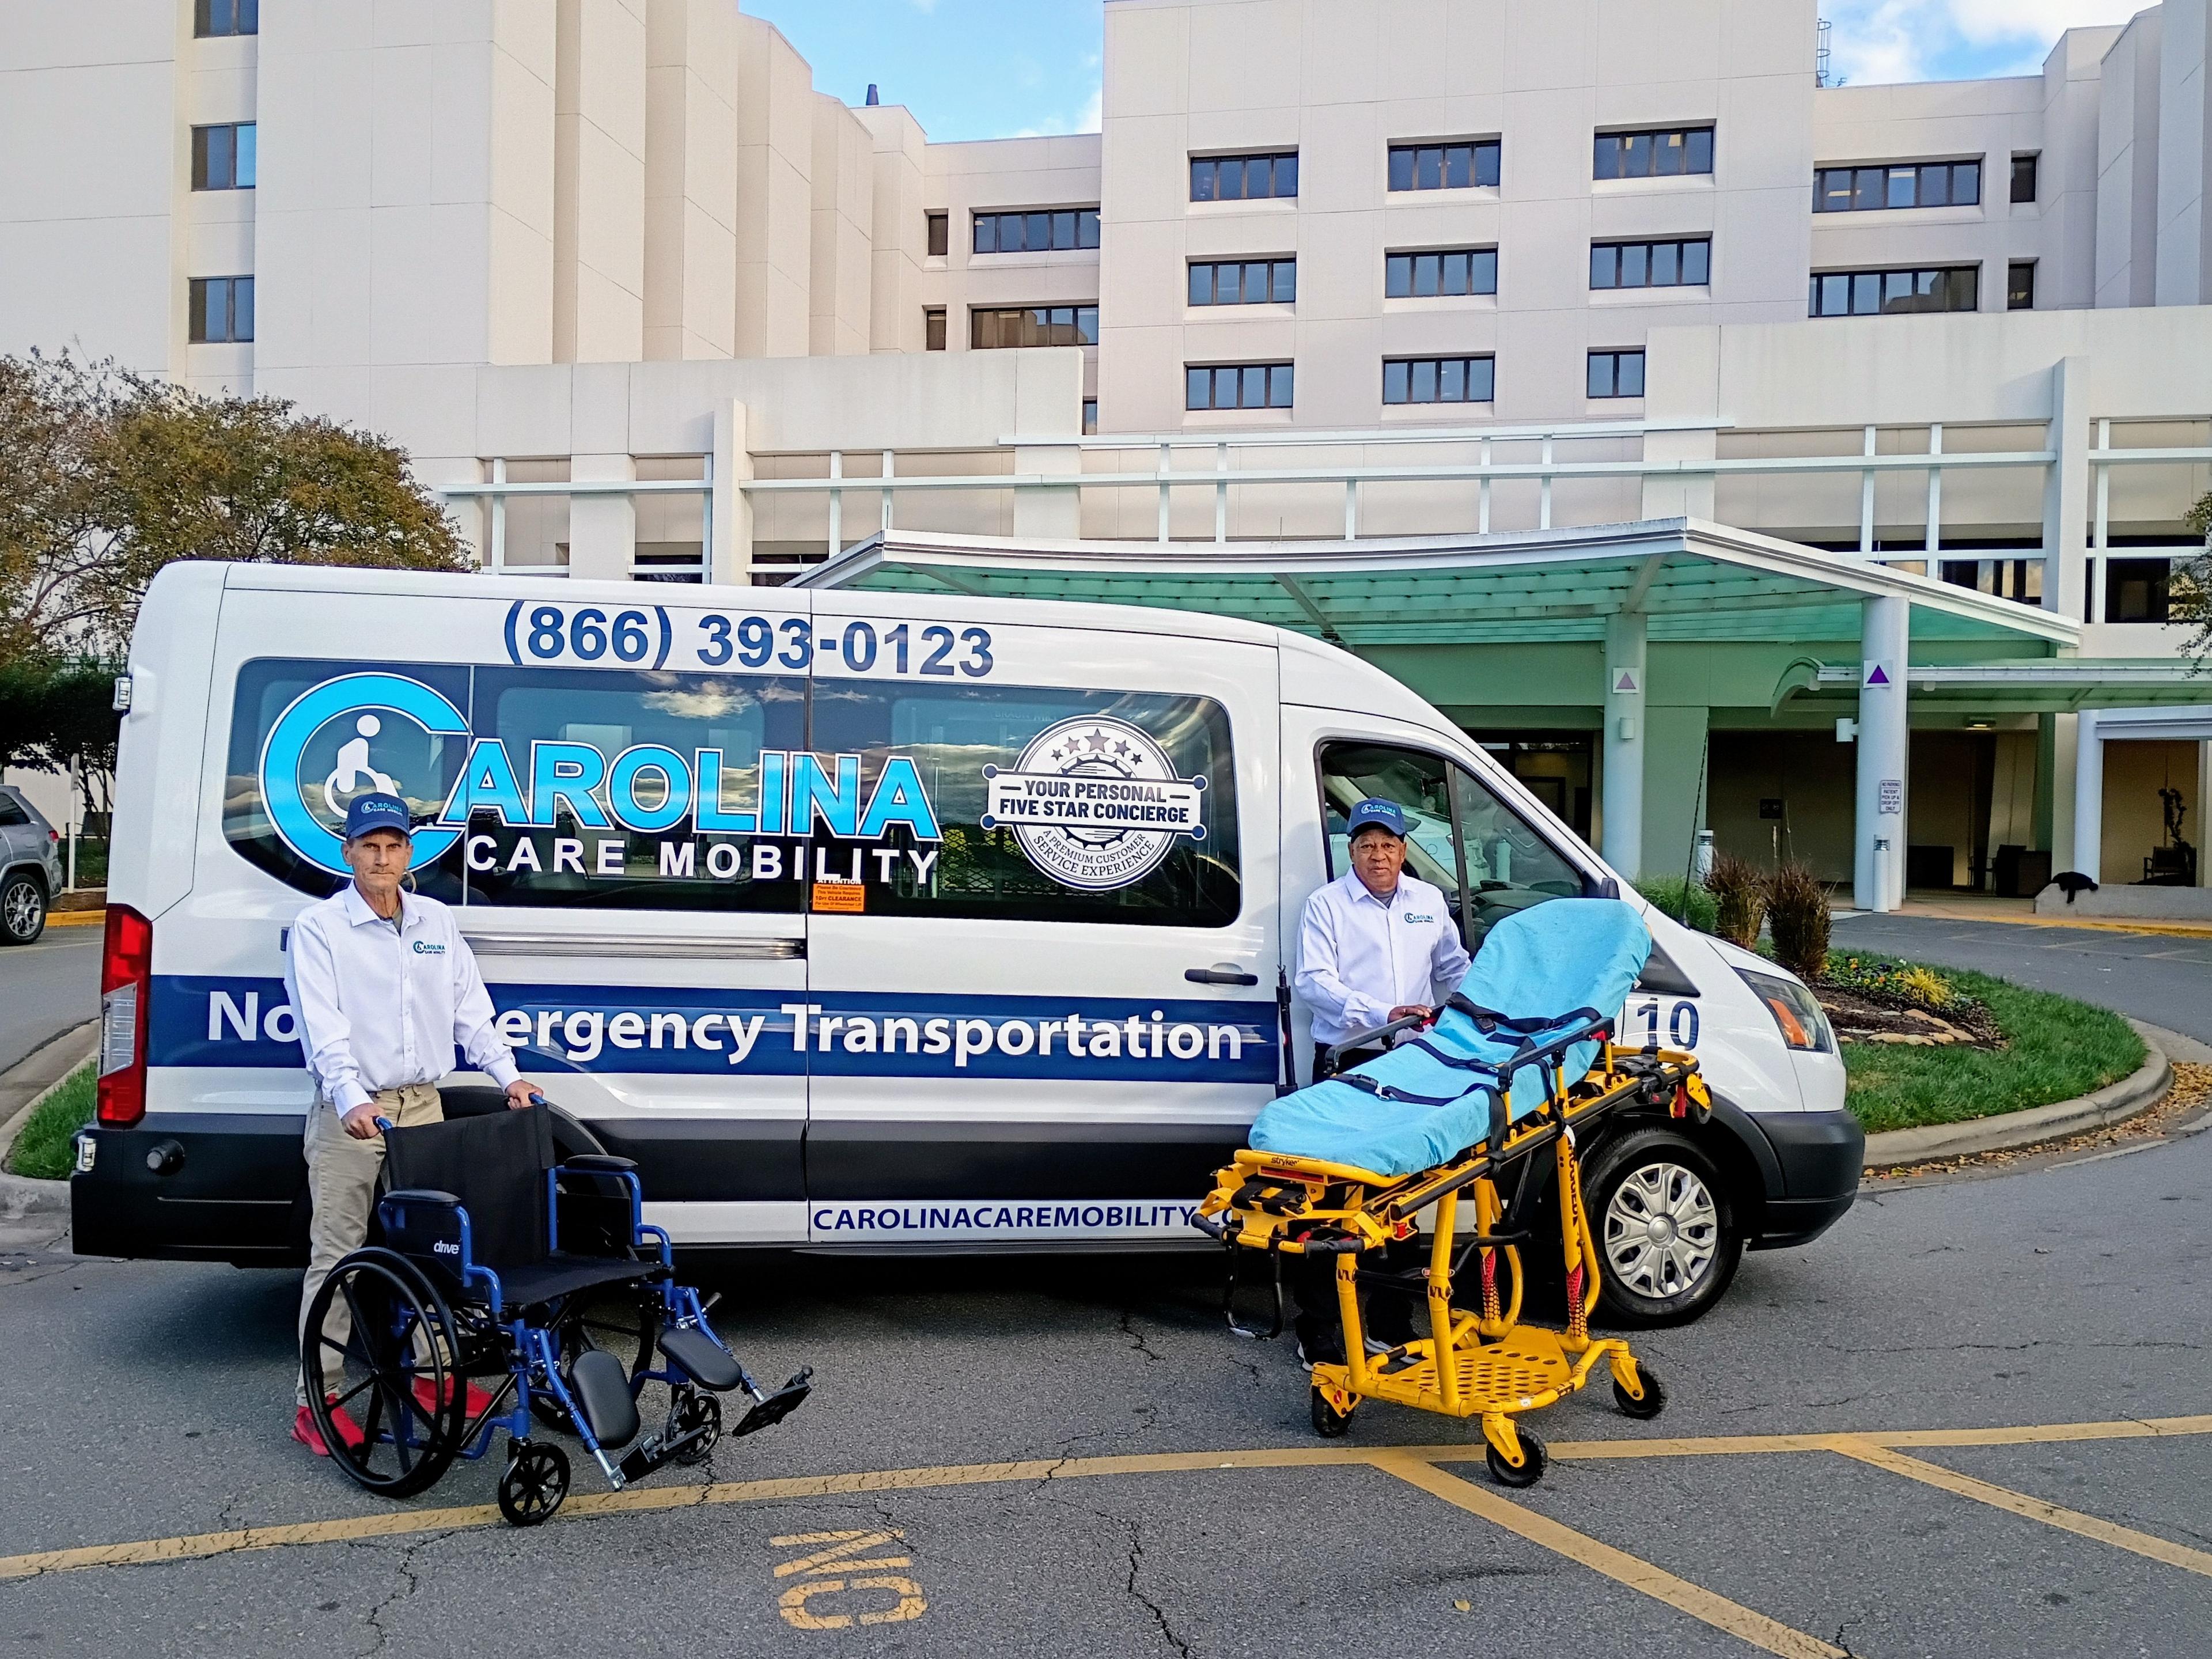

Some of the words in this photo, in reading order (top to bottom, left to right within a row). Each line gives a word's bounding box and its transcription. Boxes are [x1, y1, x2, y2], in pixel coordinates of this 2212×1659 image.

[505, 600, 672, 671] (866)
[697, 614, 994, 677] 393-0123
[258, 671, 944, 879] CAROLINA
[1025, 780, 1070, 798] YOUR
[1075, 783, 1167, 802] PERSONAL
[361, 801, 402, 813] CAROLINA
[999, 798, 1039, 815] FIVE
[1043, 801, 1089, 818] STAR
[1094, 804, 1189, 823] CONCIERGE
[1361, 804, 1396, 814] CAROLINA
[1033, 835, 1079, 873] SERVICE
[1081, 840, 1155, 876] EXPERIENCE
[1043, 830, 1051, 838] A
[1049, 836, 1094, 863] PREMIUM
[1096, 834, 1146, 864] CUSTOMER
[467, 835, 627, 875] CARE
[660, 841, 938, 885] MOBILITY
[413, 940, 445, 954] CAROLINA
[781, 1003, 1241, 1067] Transportation
[1271, 1156, 1298, 1166] stryker
[433, 1240, 460, 1255] drive
